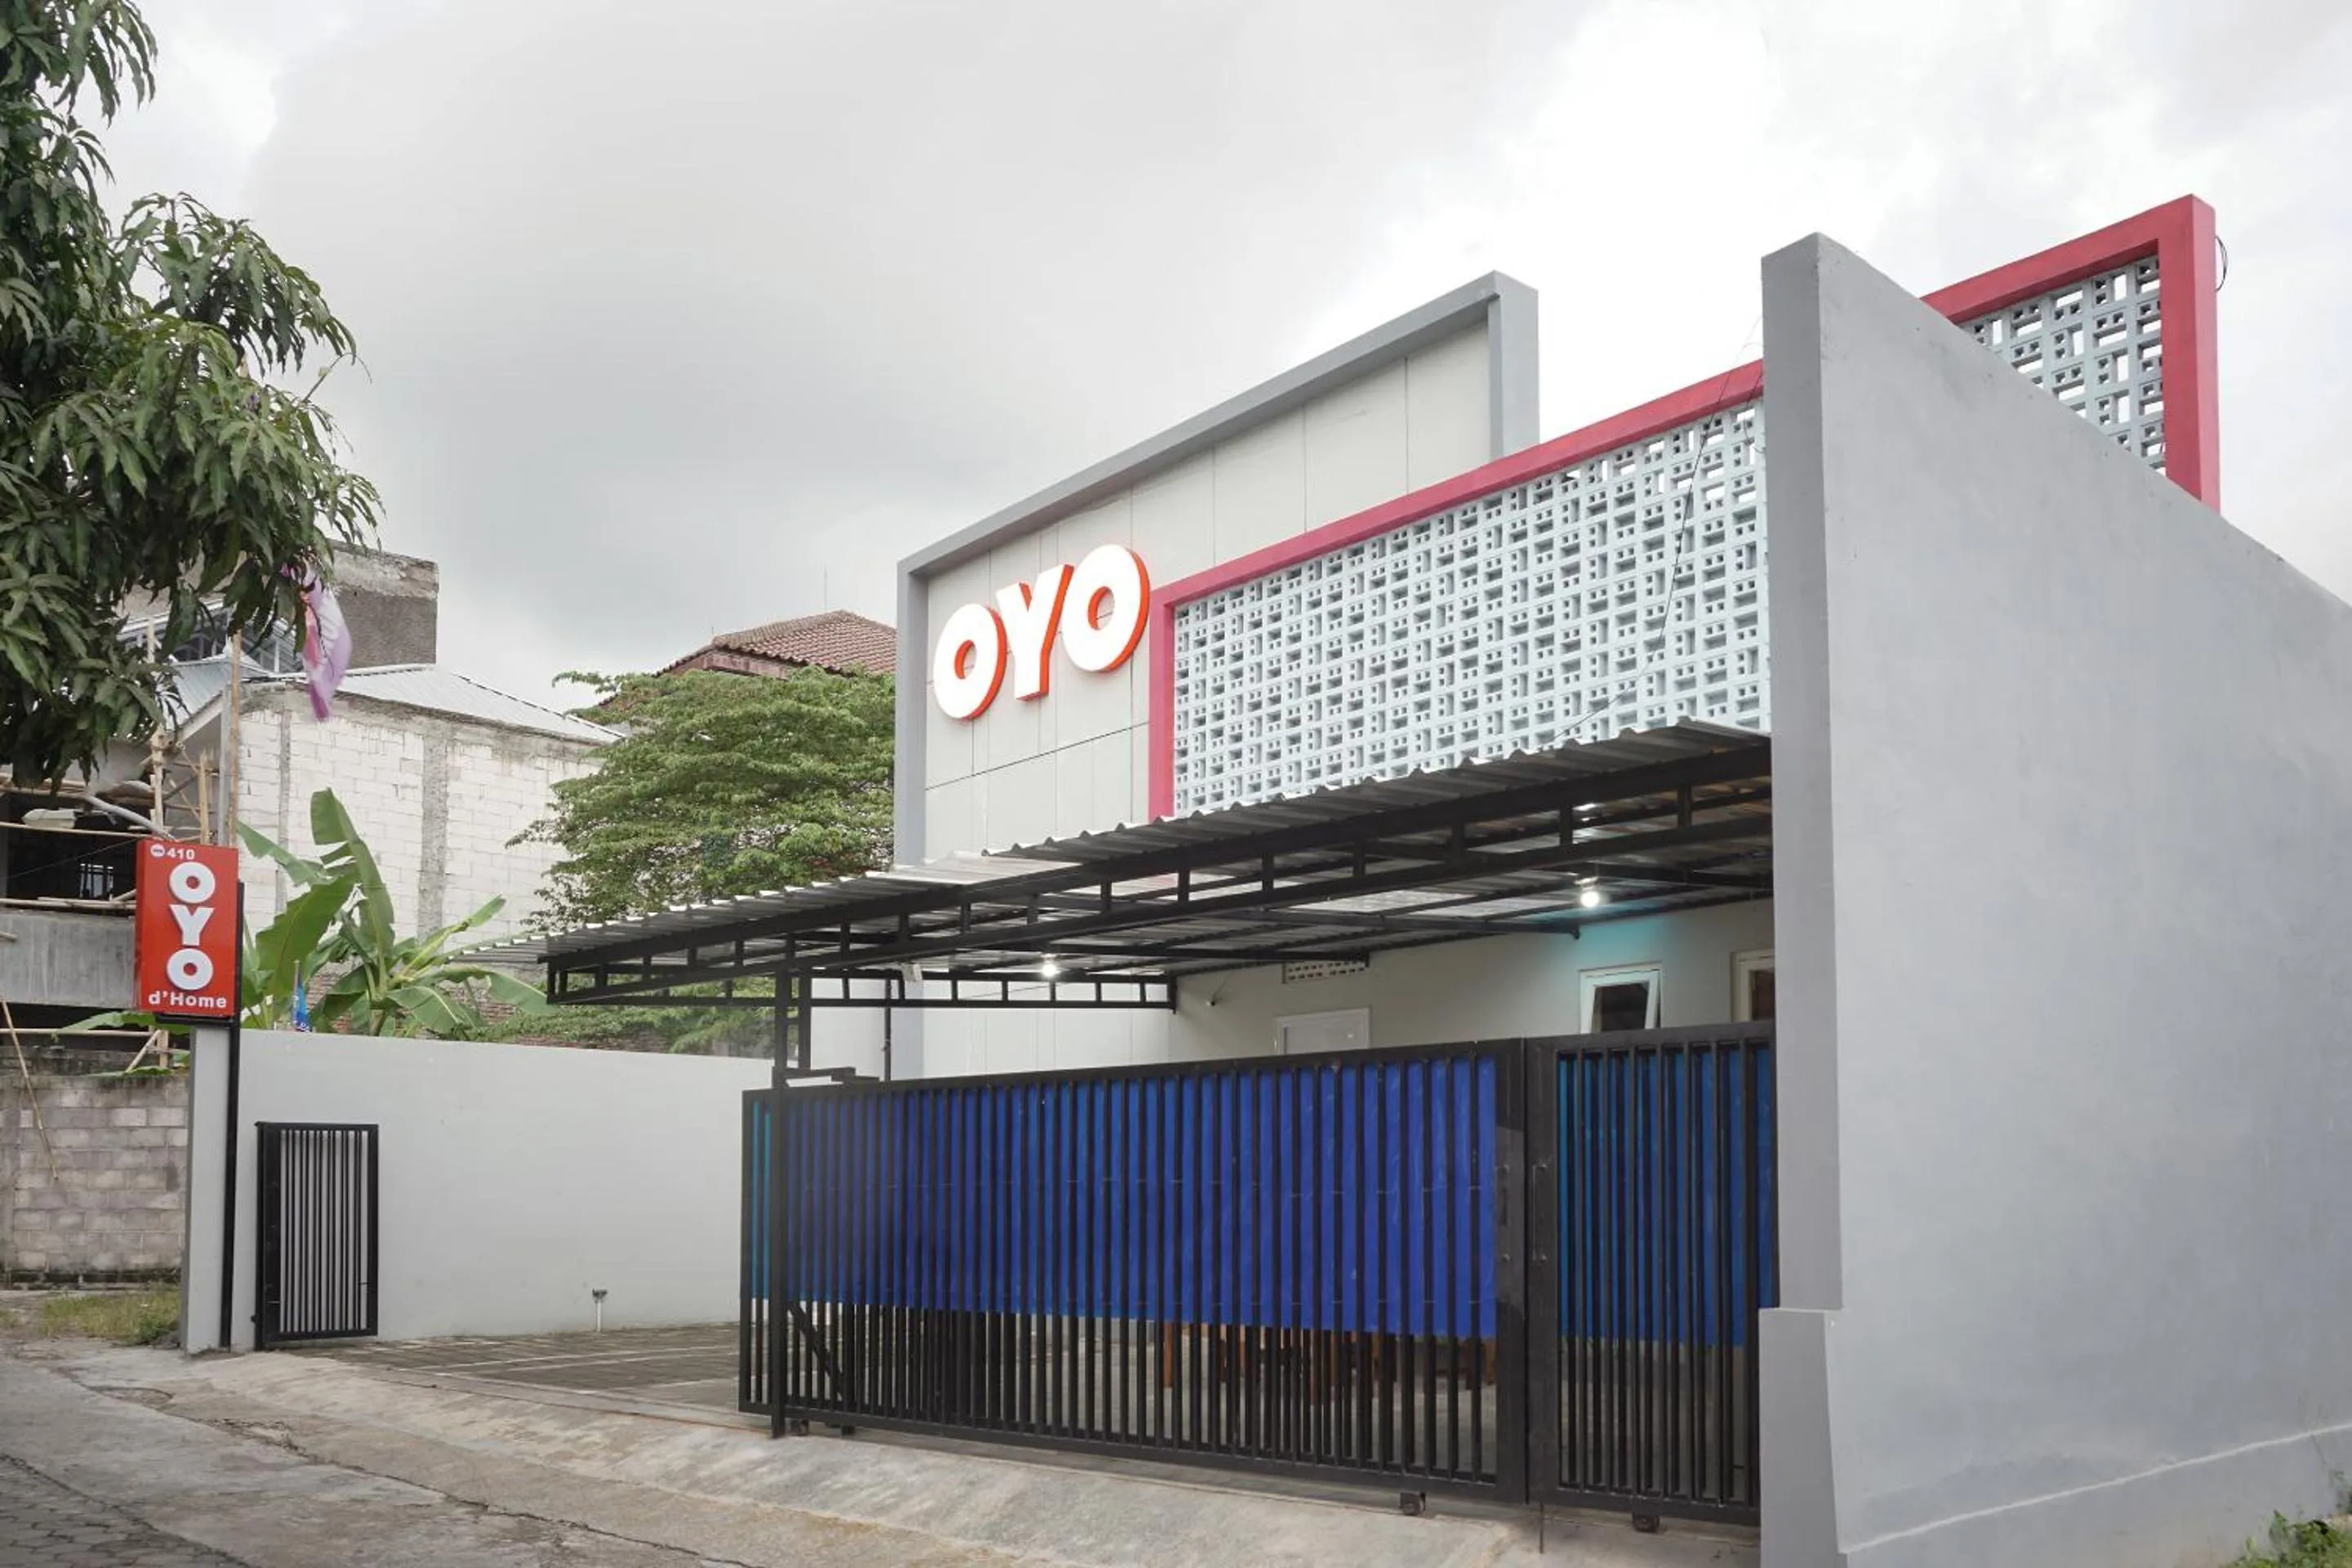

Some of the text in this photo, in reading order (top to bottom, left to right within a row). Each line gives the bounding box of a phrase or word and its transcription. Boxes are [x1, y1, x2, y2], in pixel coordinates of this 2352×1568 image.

[933, 544, 1150, 721] OYO
[167, 848, 195, 860] 410
[167, 862, 216, 991] OYO
